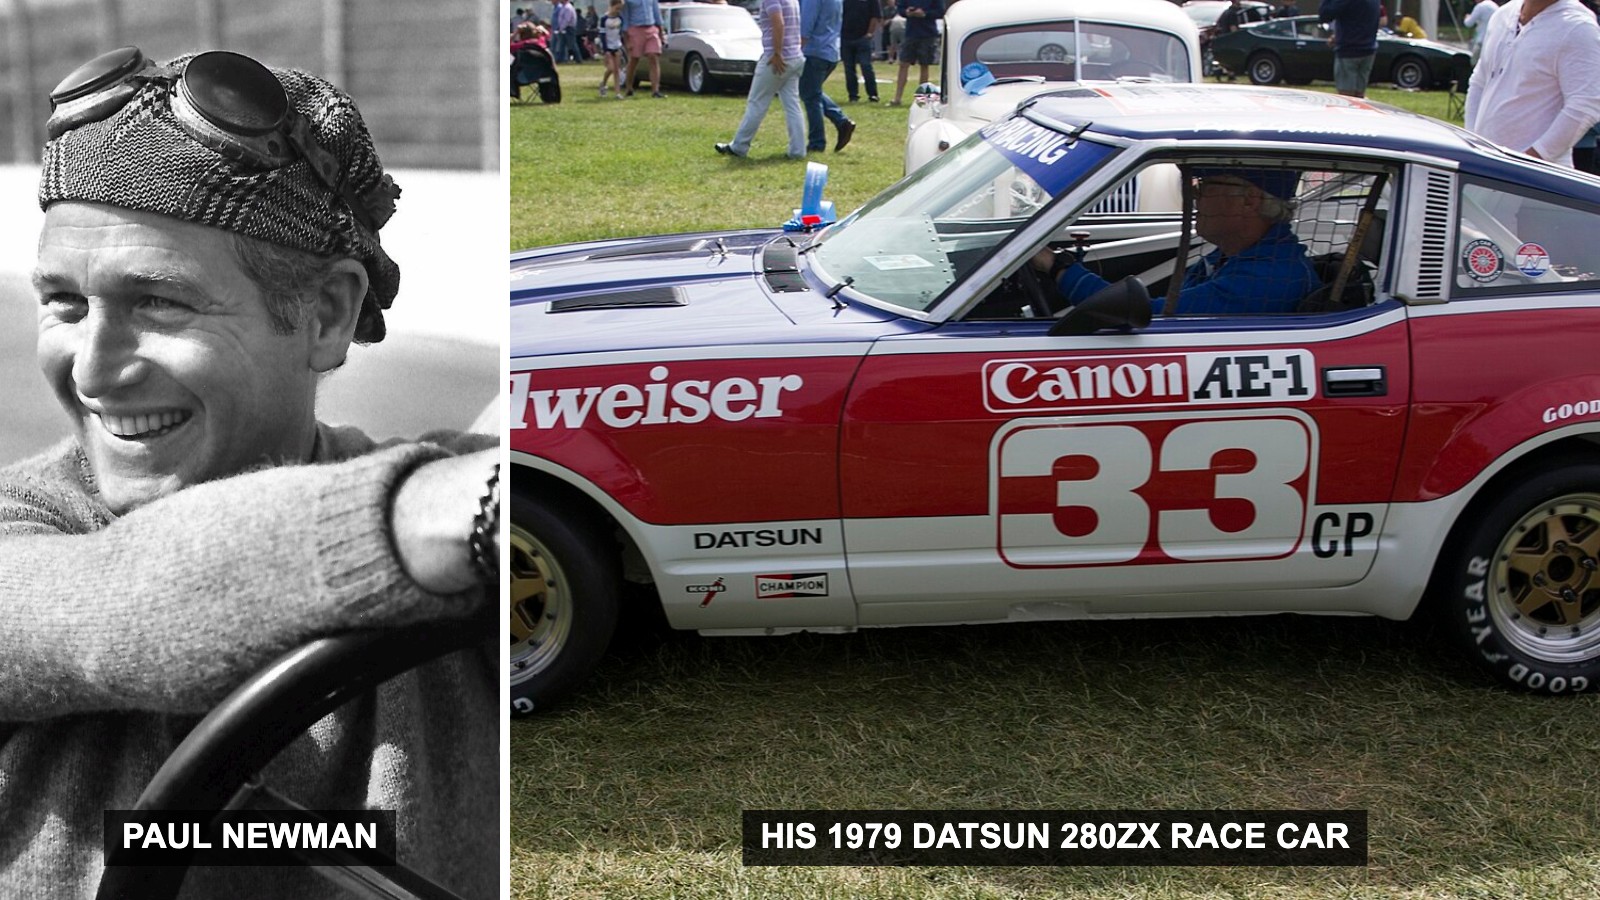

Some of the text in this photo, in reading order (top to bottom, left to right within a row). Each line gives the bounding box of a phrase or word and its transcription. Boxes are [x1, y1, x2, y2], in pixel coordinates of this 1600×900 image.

[989, 354, 1310, 405] Canon AE-1
[1000, 418, 1309, 565] 33
[693, 527, 823, 550] DATSUN
[1310, 511, 1375, 560] CP
[759, 580, 825, 593] CHAMPION
